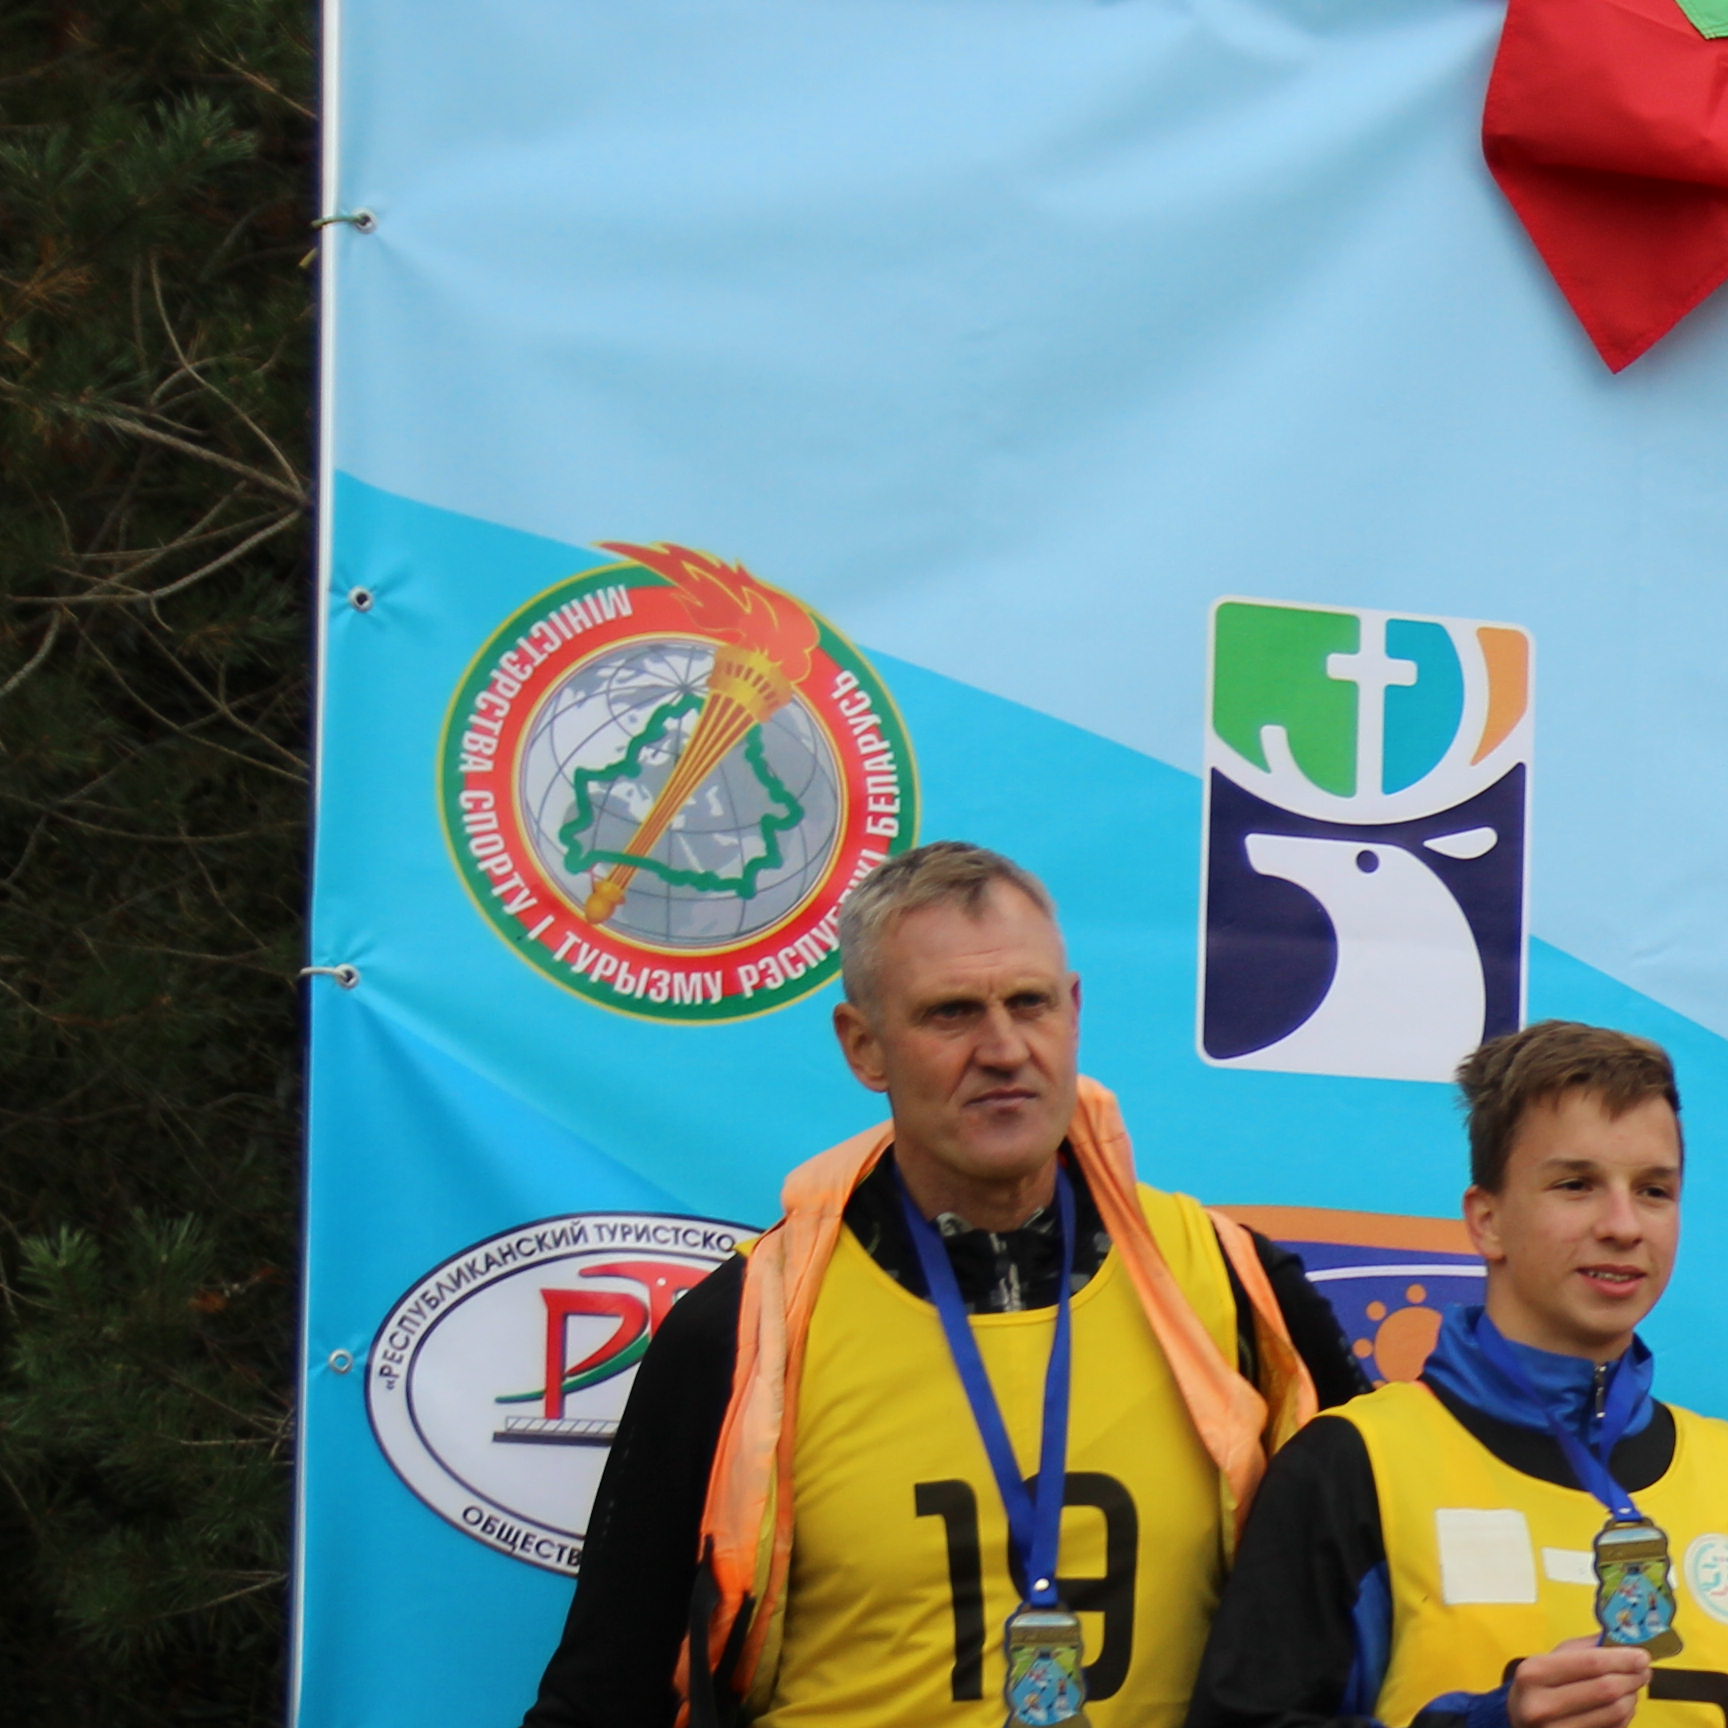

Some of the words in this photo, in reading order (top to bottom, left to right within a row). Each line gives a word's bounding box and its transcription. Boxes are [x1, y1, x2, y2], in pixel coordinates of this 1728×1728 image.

[458, 584, 633, 774] МІНІСТЭРСТВА
[831, 669, 901, 839] БЕЛАРУСЬ
[459, 789, 538, 916] СПОРТУ
[552, 928, 724, 1006] ТУРЫЗМУ
[462, 1504, 580, 1567] ОБЩЕСТВ
[914, 1471, 1139, 1702] 19
